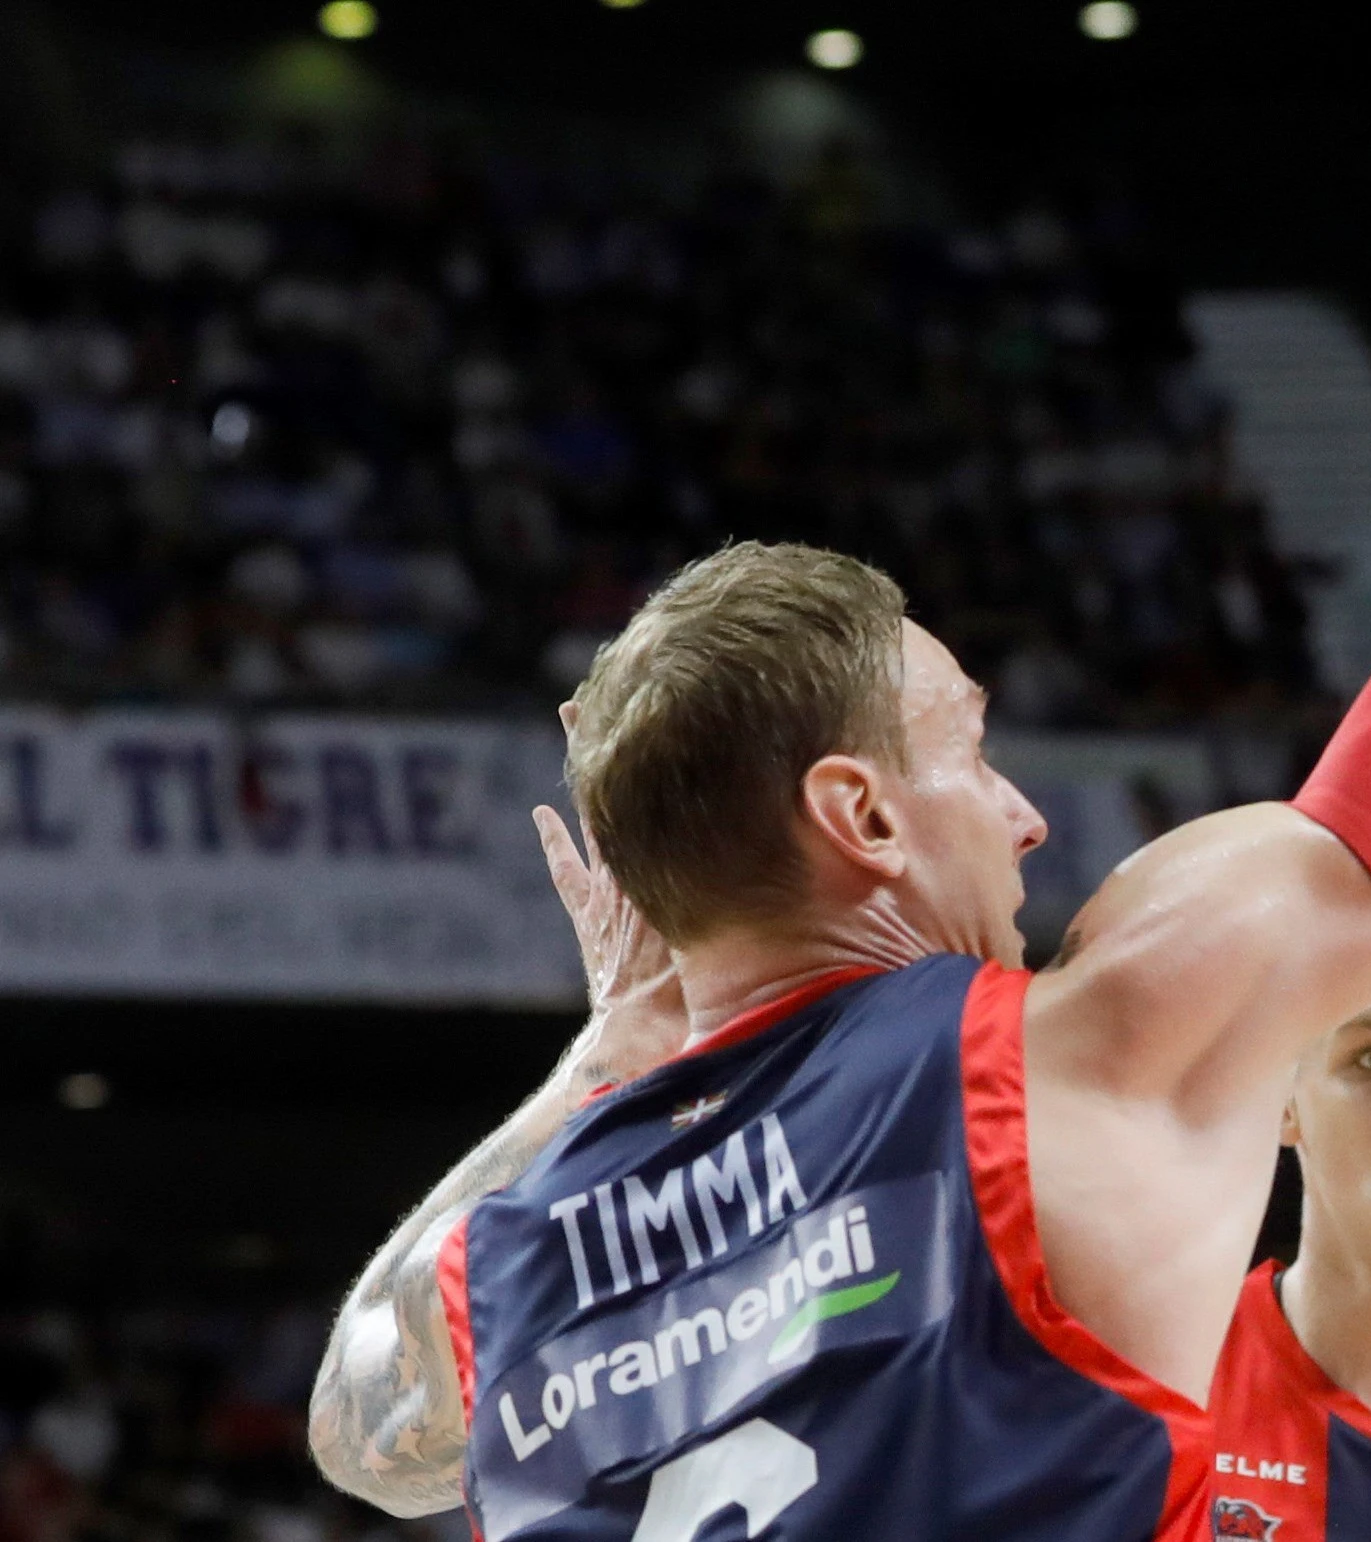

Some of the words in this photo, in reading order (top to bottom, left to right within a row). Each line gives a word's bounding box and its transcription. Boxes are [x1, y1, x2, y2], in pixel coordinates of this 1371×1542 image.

[106, 739, 483, 858] TIGRE
[549, 1111, 808, 1311] TIMMA
[499, 1205, 876, 1463] Loramendi
